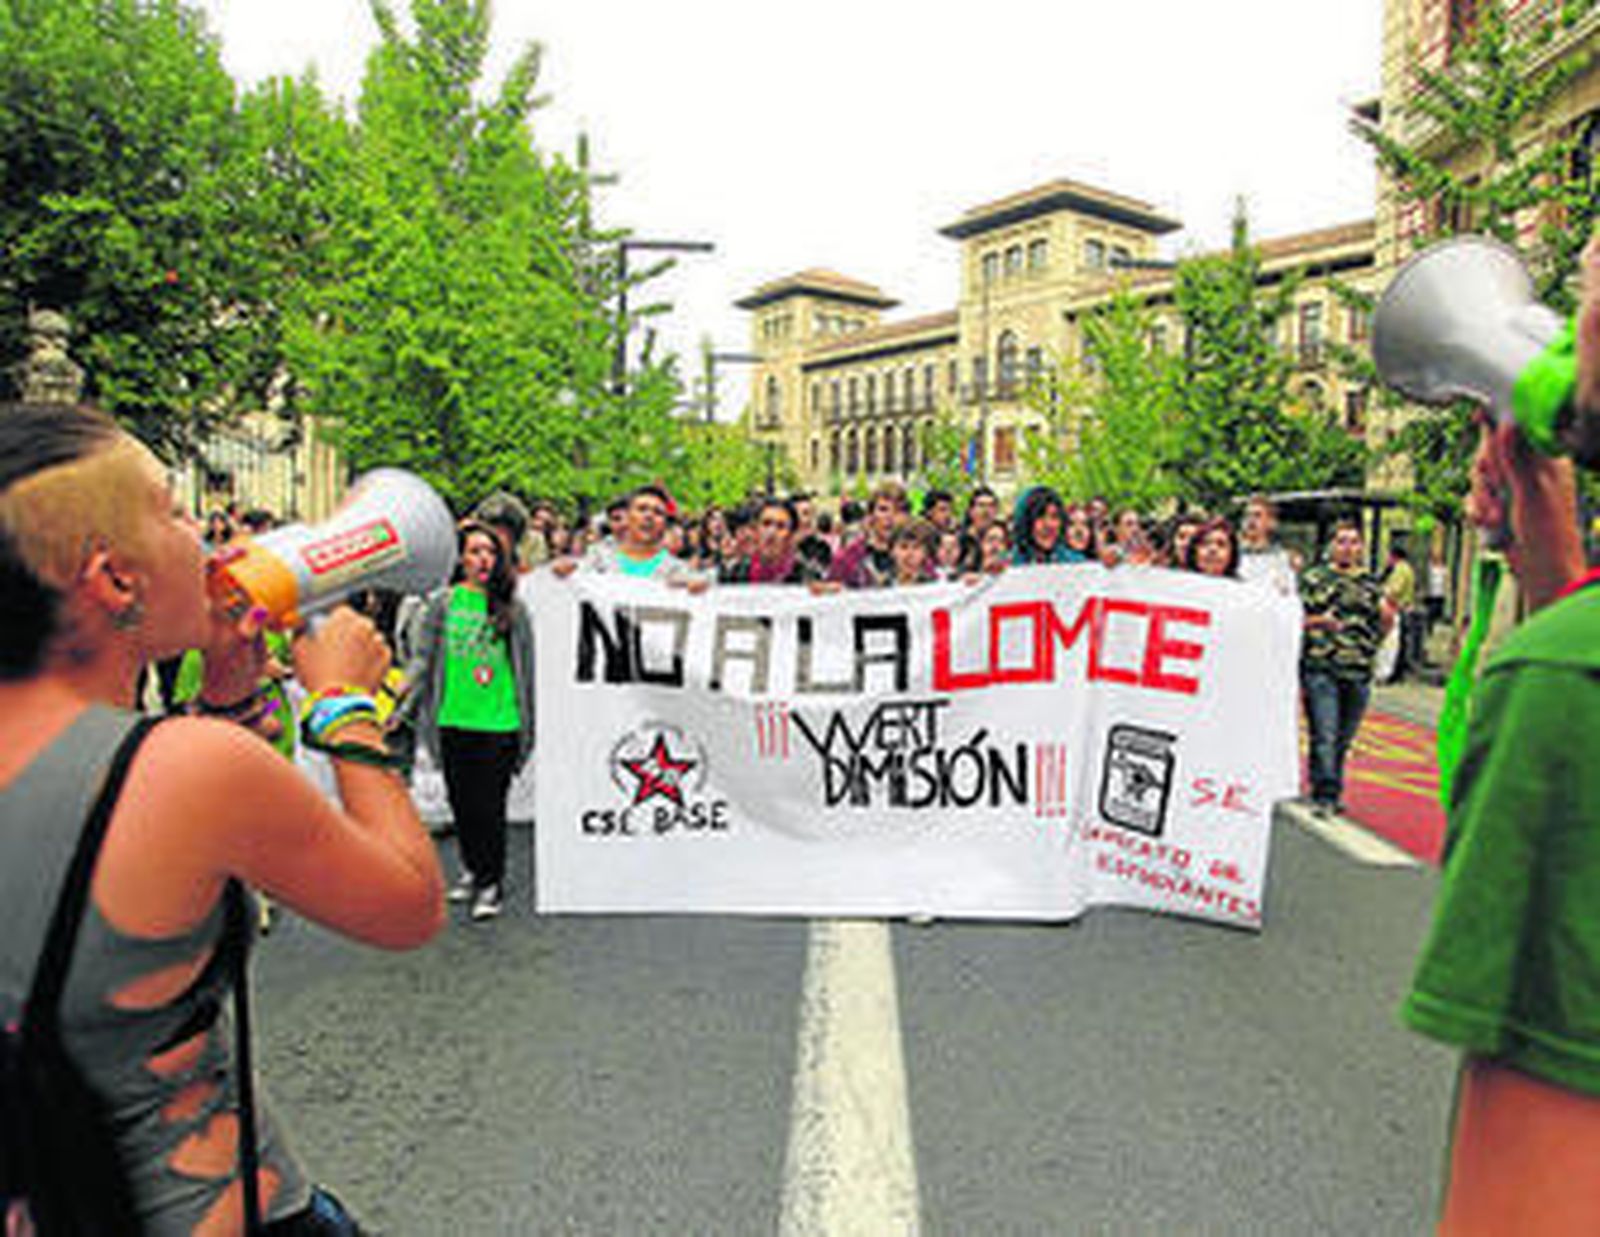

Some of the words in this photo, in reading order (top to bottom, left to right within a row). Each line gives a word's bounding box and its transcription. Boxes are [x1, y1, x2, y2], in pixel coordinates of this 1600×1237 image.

[576, 600, 691, 688] NO
[709, 615, 772, 693] A
[795, 612, 910, 693] LA
[931, 595, 1211, 695] LOMCE
